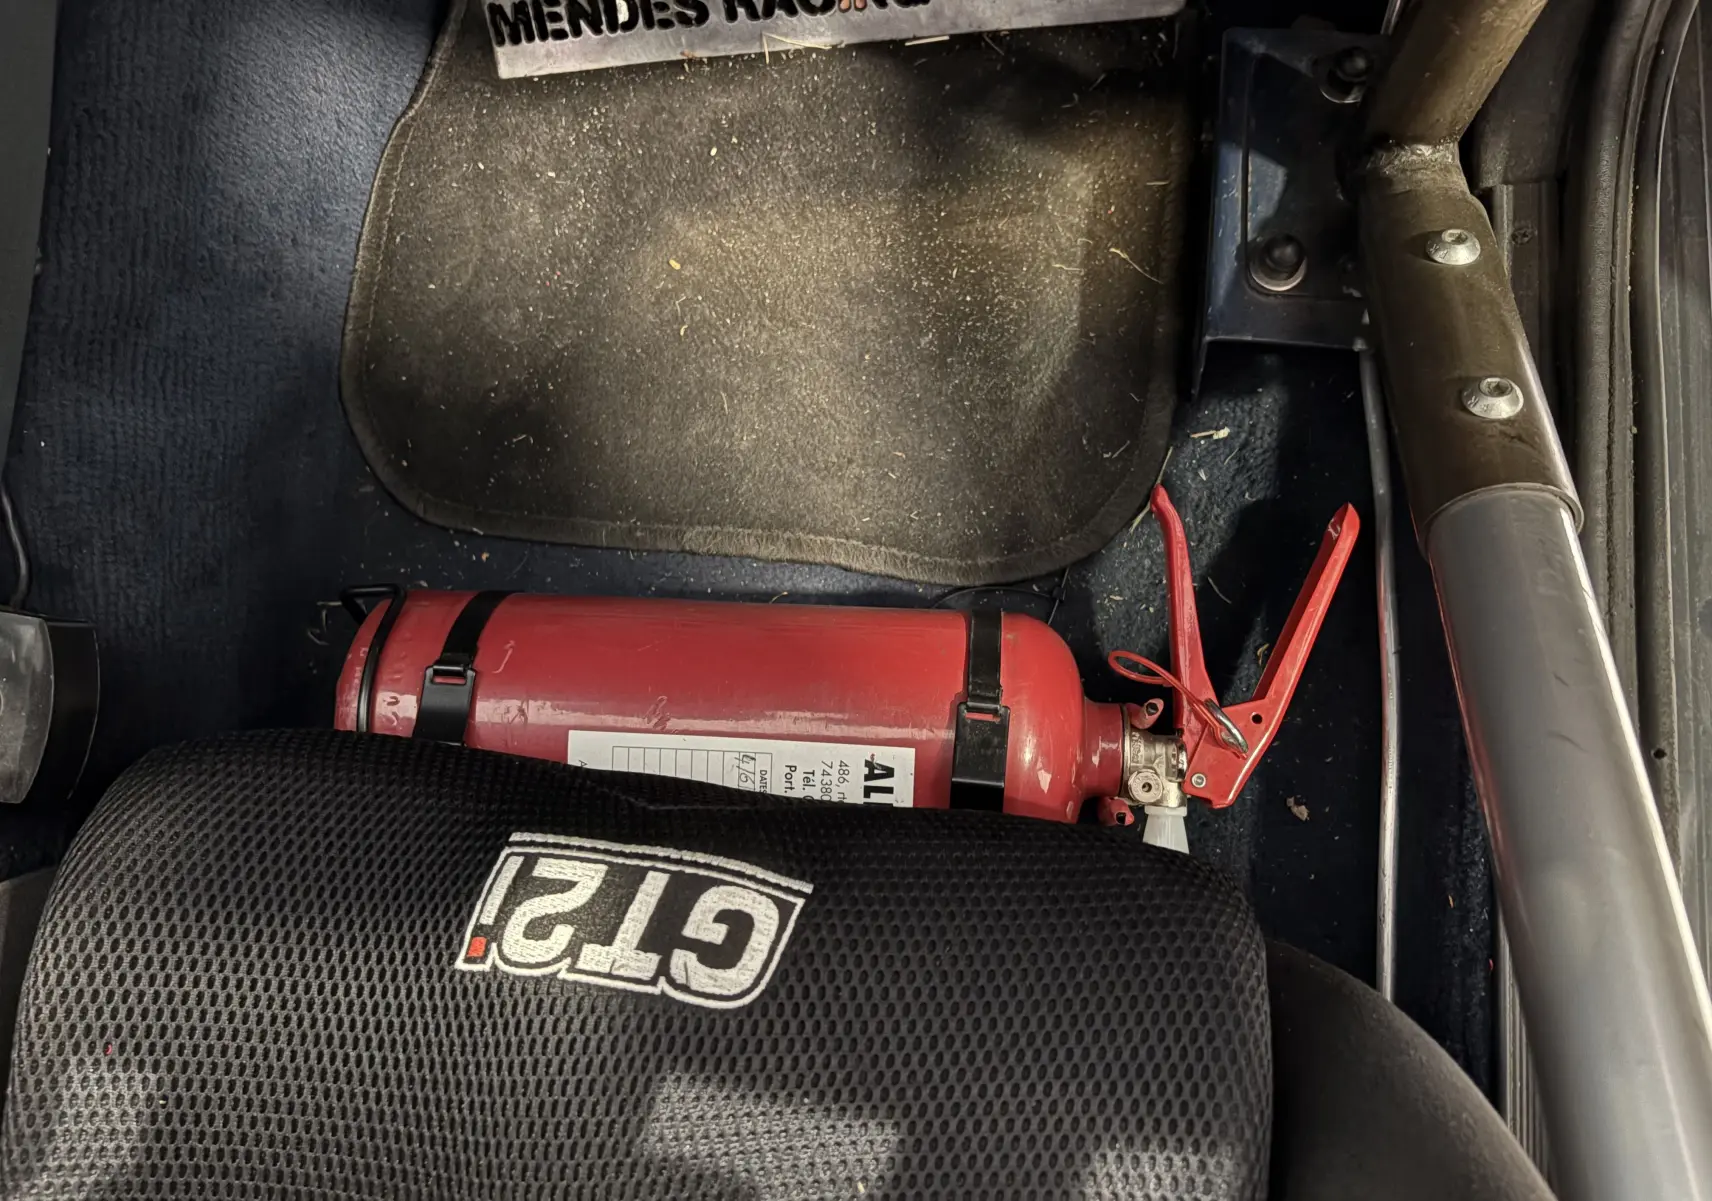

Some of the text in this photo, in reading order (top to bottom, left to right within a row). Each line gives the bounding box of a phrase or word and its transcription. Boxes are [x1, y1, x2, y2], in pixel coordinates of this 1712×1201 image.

[486, 0, 710, 46] MENDES
[784, 764, 797, 794] Port.
[802, 769, 816, 791] Tél.
[835, 760, 850, 788] 486,
[863, 759, 895, 807] AL
